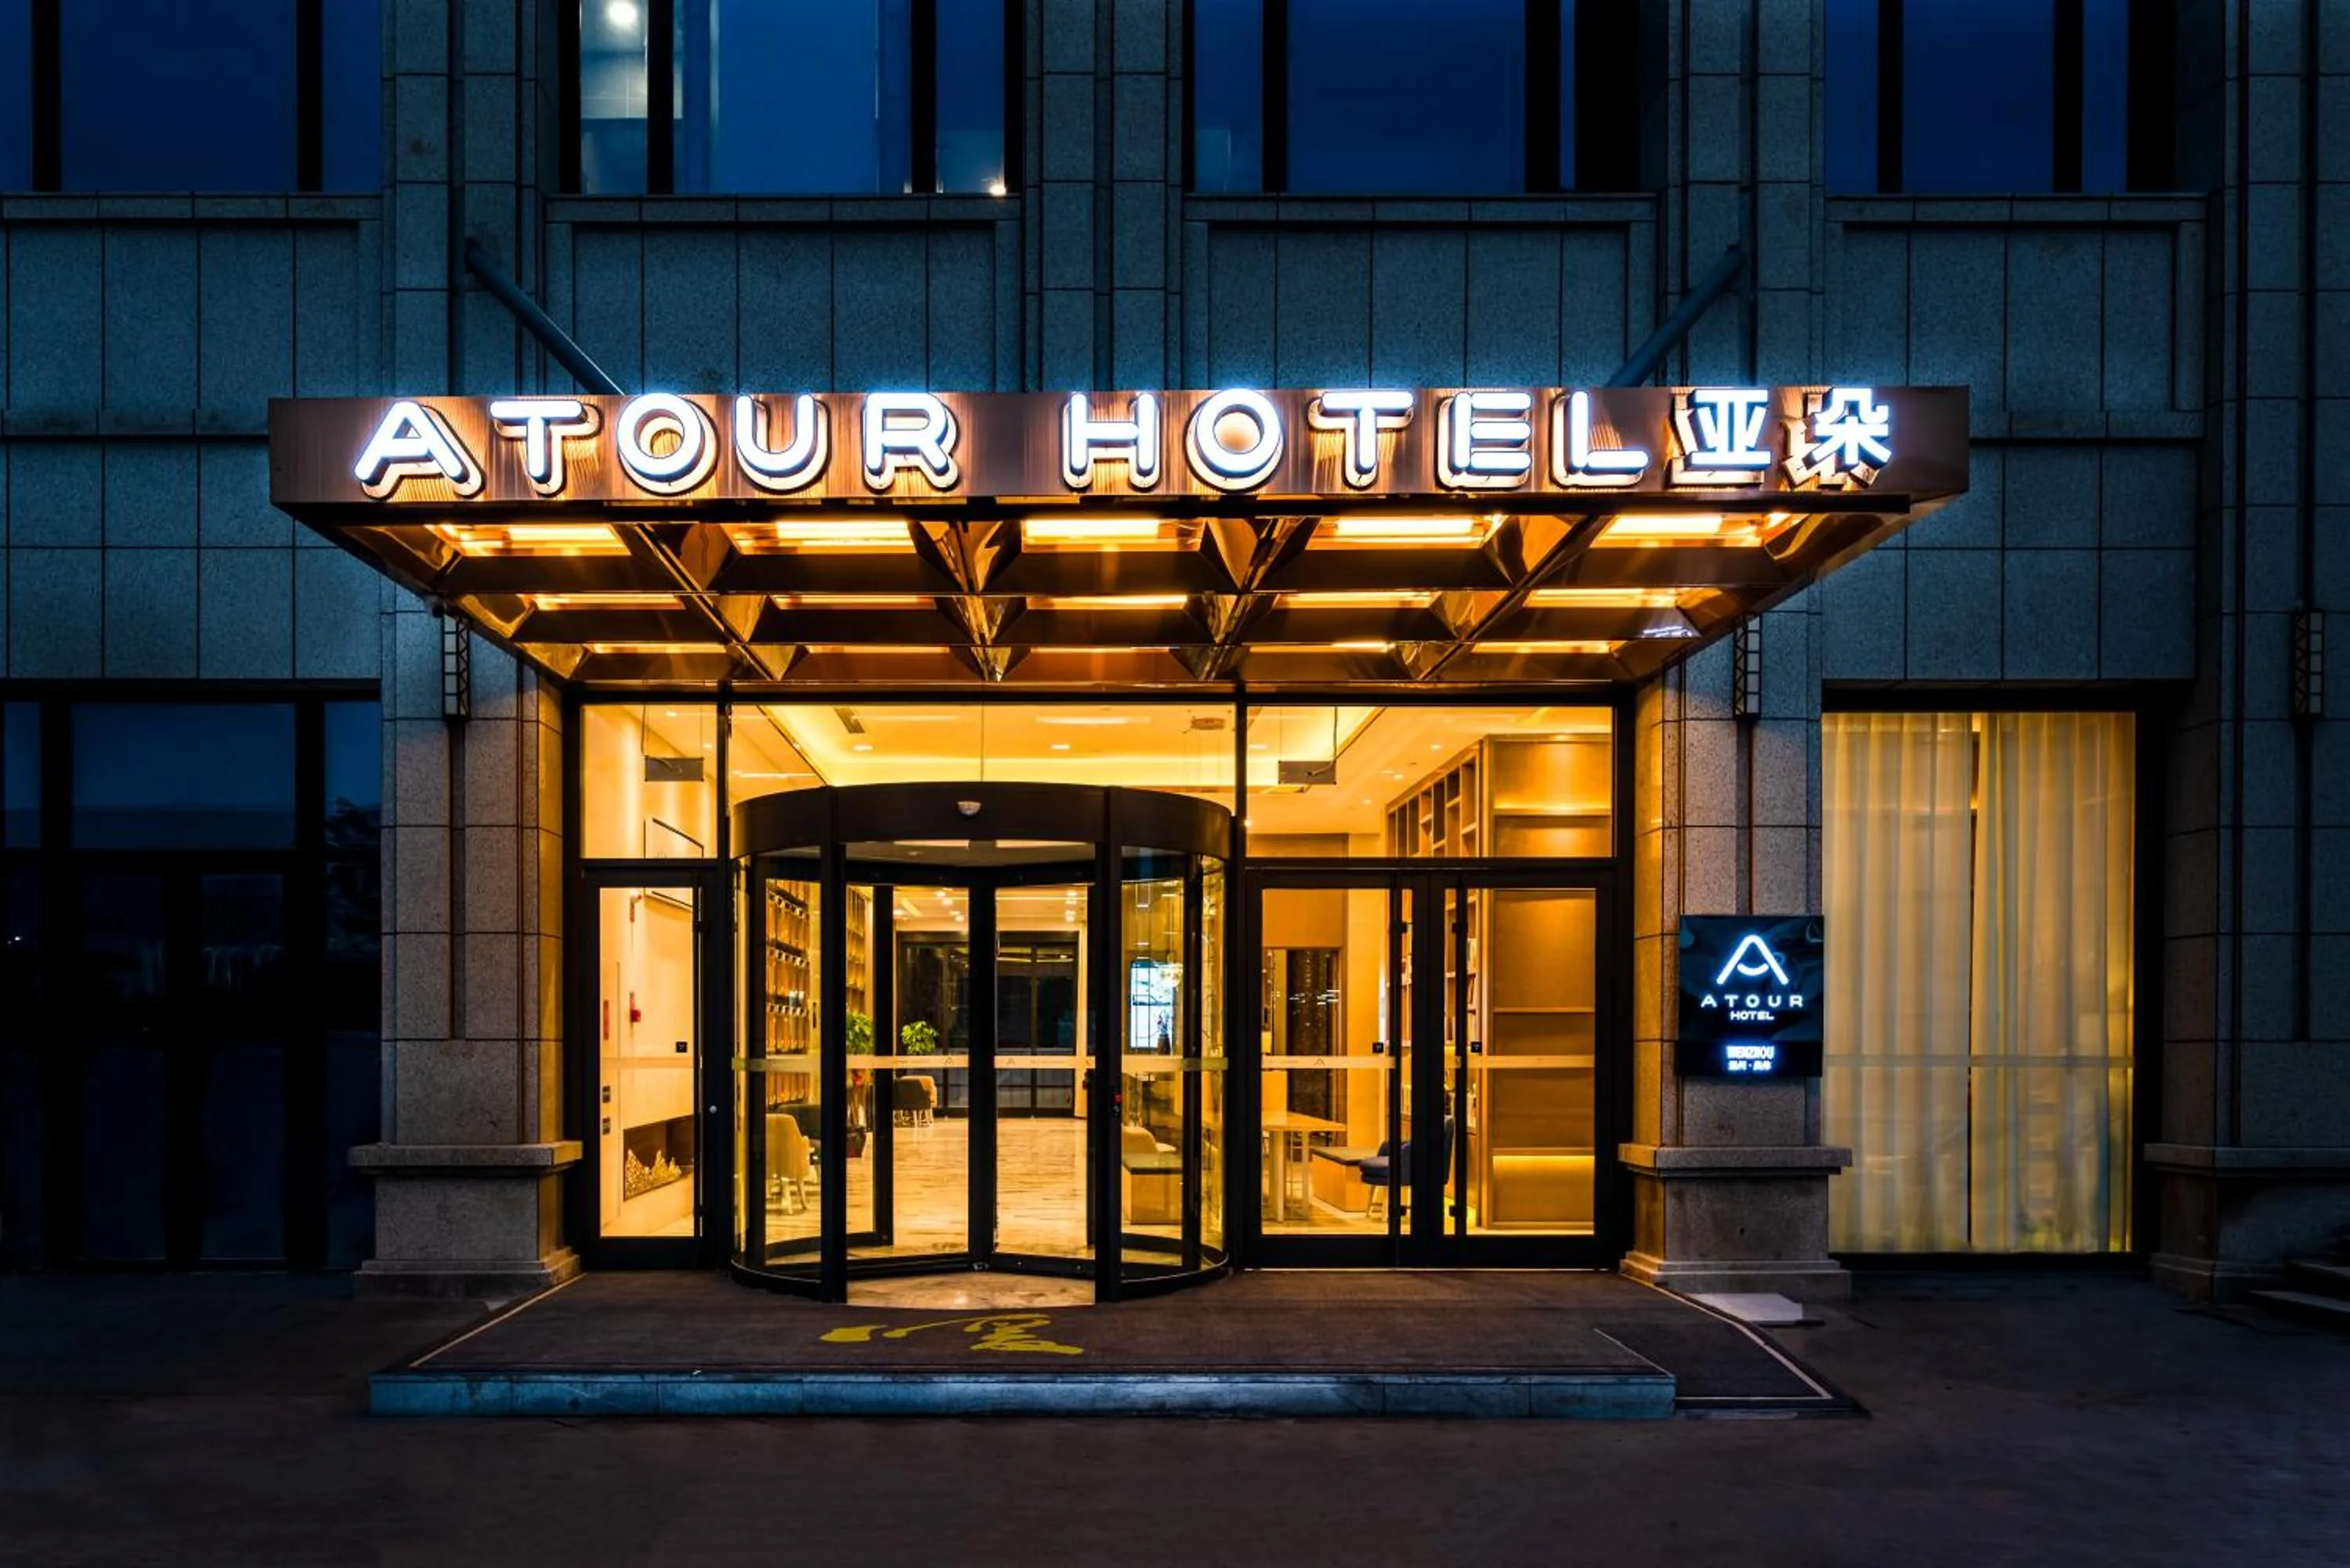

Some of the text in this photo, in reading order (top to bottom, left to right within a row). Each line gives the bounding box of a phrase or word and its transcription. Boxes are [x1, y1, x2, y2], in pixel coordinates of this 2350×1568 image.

[354, 388, 1650, 498] ATOUR HOTEL
[1670, 385, 1893, 489] 亚朵
[1701, 994, 1803, 1008] ATOUR
[1730, 1010, 1775, 1021] HOTEL
